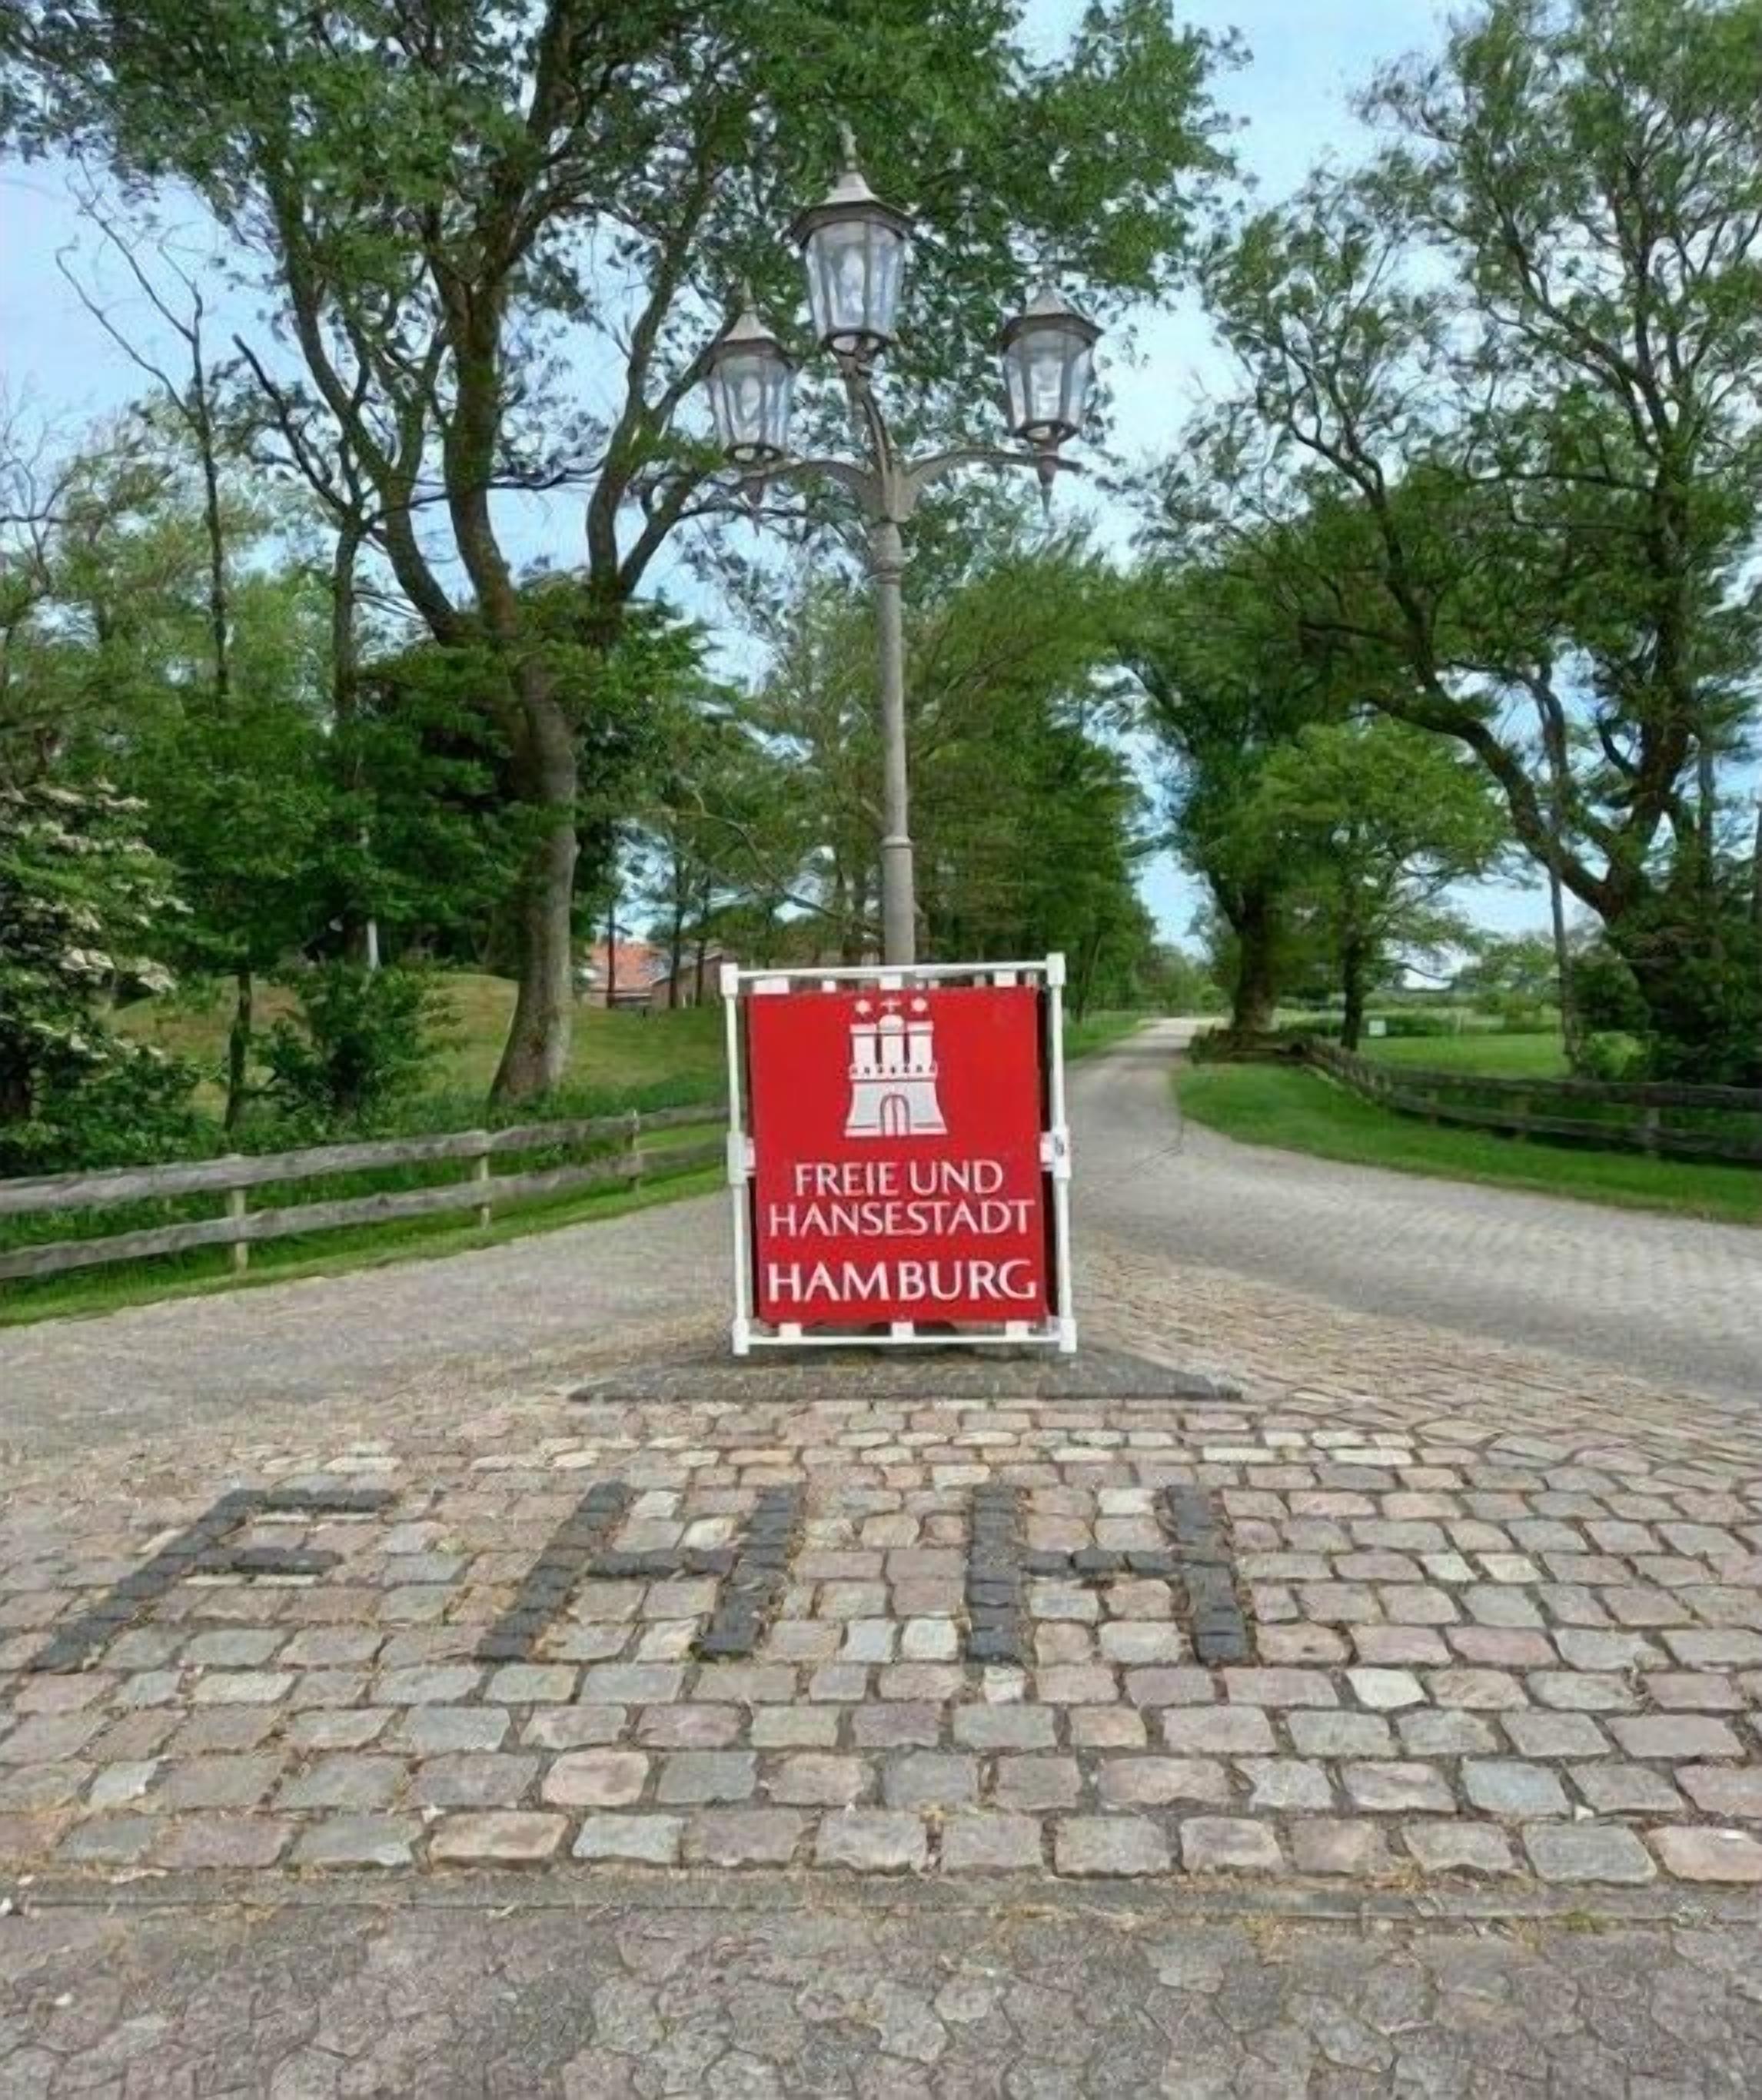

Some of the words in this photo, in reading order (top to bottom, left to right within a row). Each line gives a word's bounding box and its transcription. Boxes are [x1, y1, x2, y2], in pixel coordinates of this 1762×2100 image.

[795, 1162, 899, 1197] FREIE
[909, 1160, 1003, 1195] UND
[769, 1199, 1036, 1237] HANSESTADT
[768, 1259, 1037, 1302] HAMBURG
